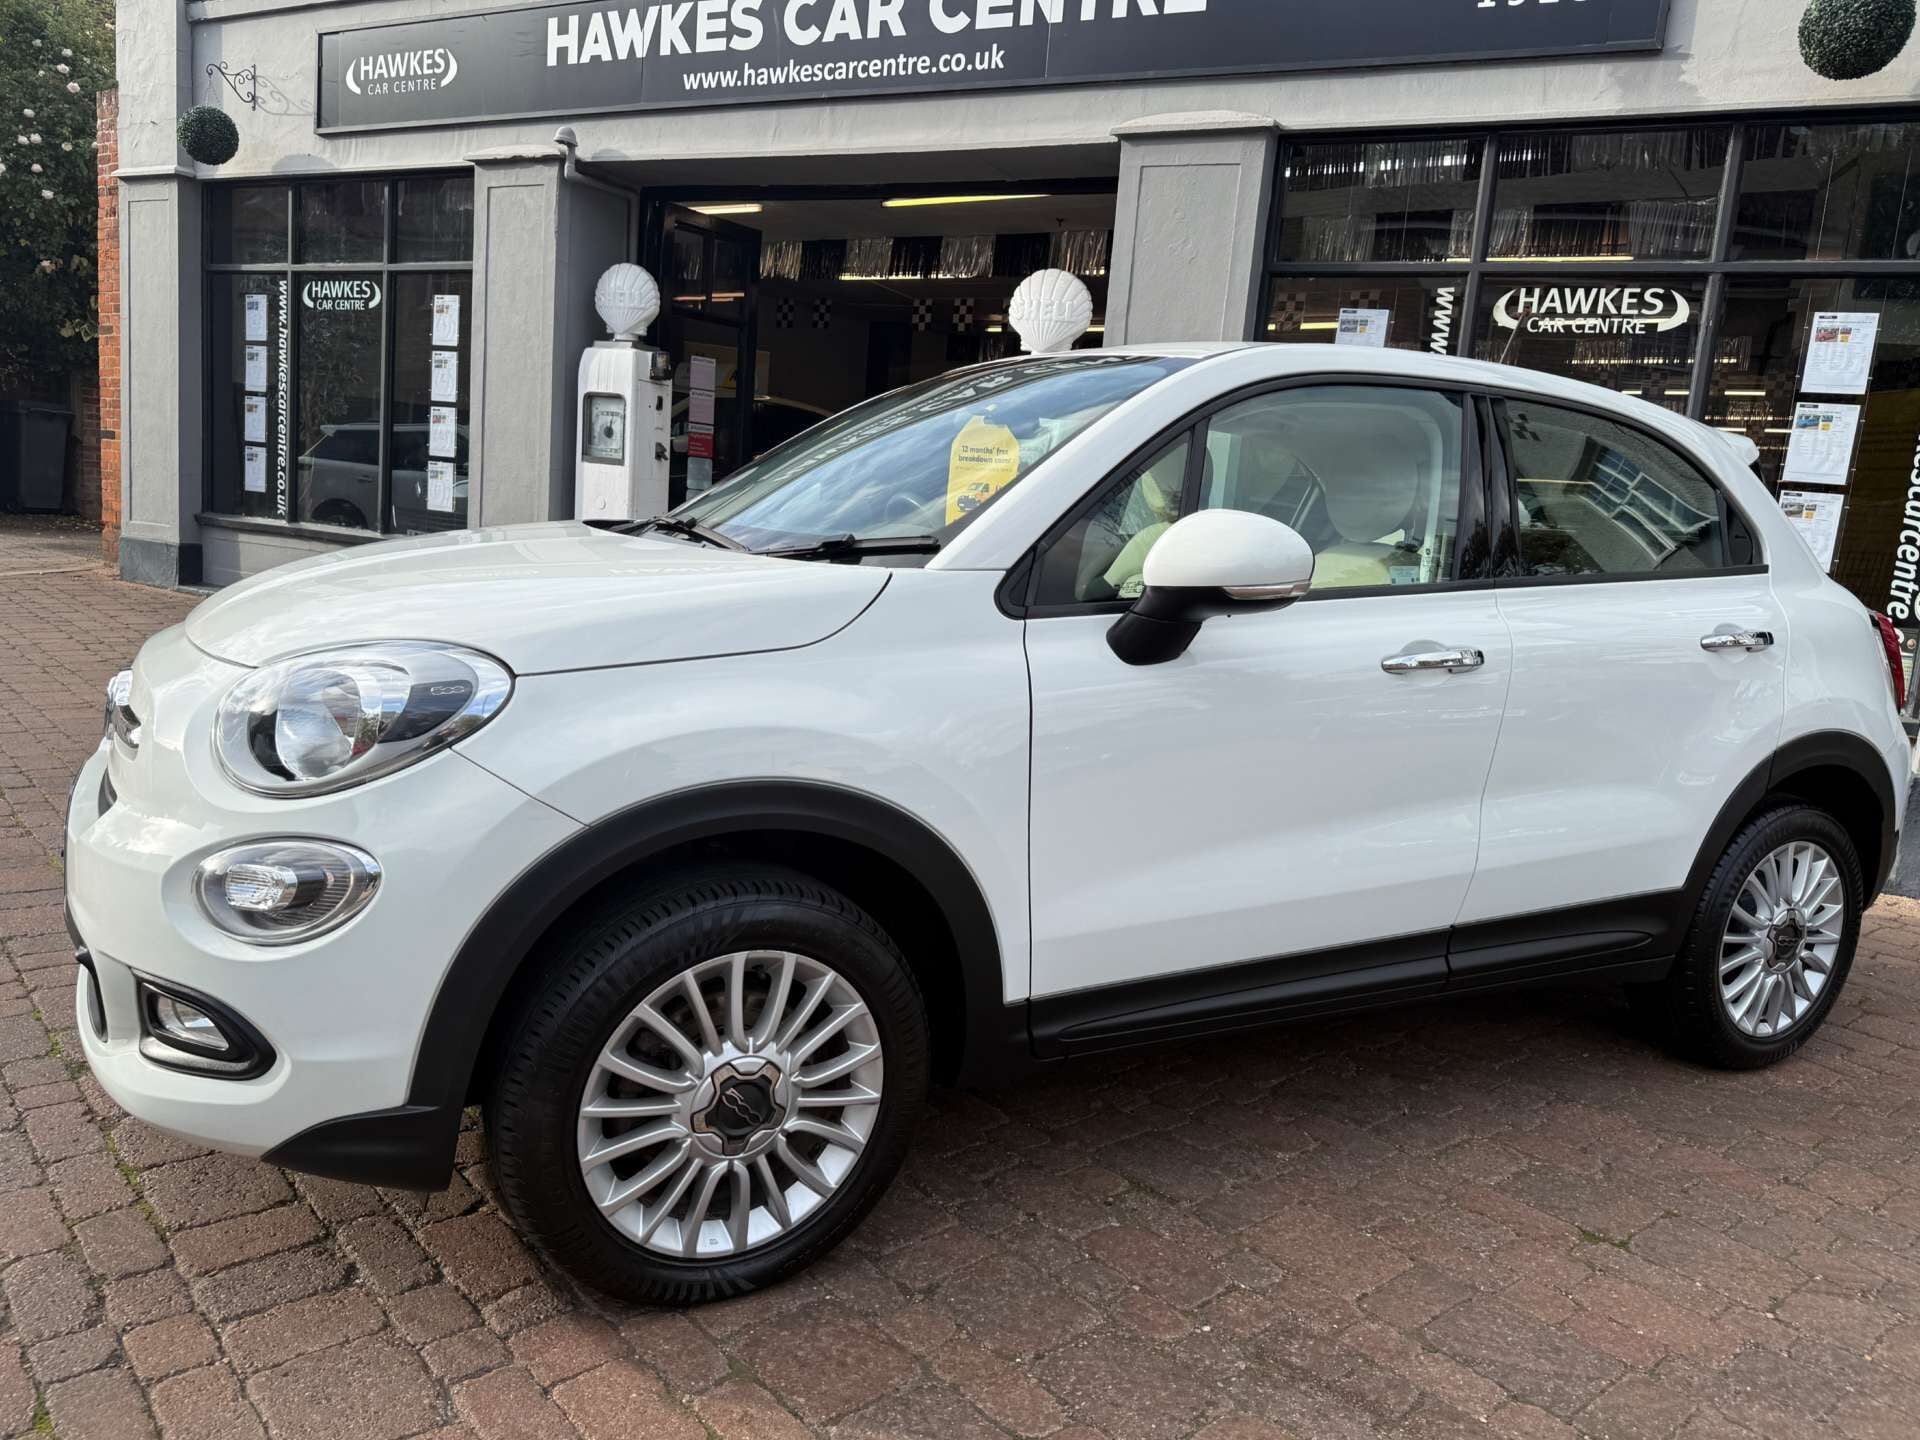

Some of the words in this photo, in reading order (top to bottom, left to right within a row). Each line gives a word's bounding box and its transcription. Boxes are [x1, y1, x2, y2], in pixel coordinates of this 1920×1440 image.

[547, 0, 764, 67] HAWKES
[783, 0, 908, 46] CAR
[360, 48, 446, 81] HAWKES
[683, 44, 1006, 90] www.hawkescarcentre.co.uk
[367, 82, 389, 96] CAR
[393, 77, 437, 94] CENTRE
[312, 280, 371, 298] HAWKES
[597, 289, 652, 309] SHELL
[316, 299, 333, 311] CAR
[334, 299, 366, 311] CENTRE
[1013, 299, 1076, 321] SHELL
[1516, 287, 1665, 316] HAWKES
[1526, 316, 1565, 333] CAR
[1571, 316, 1647, 335] CENTRE
[276, 280, 289, 516] www.hawkescarcentre.co.uk
[959, 454, 993, 464] breakdown
